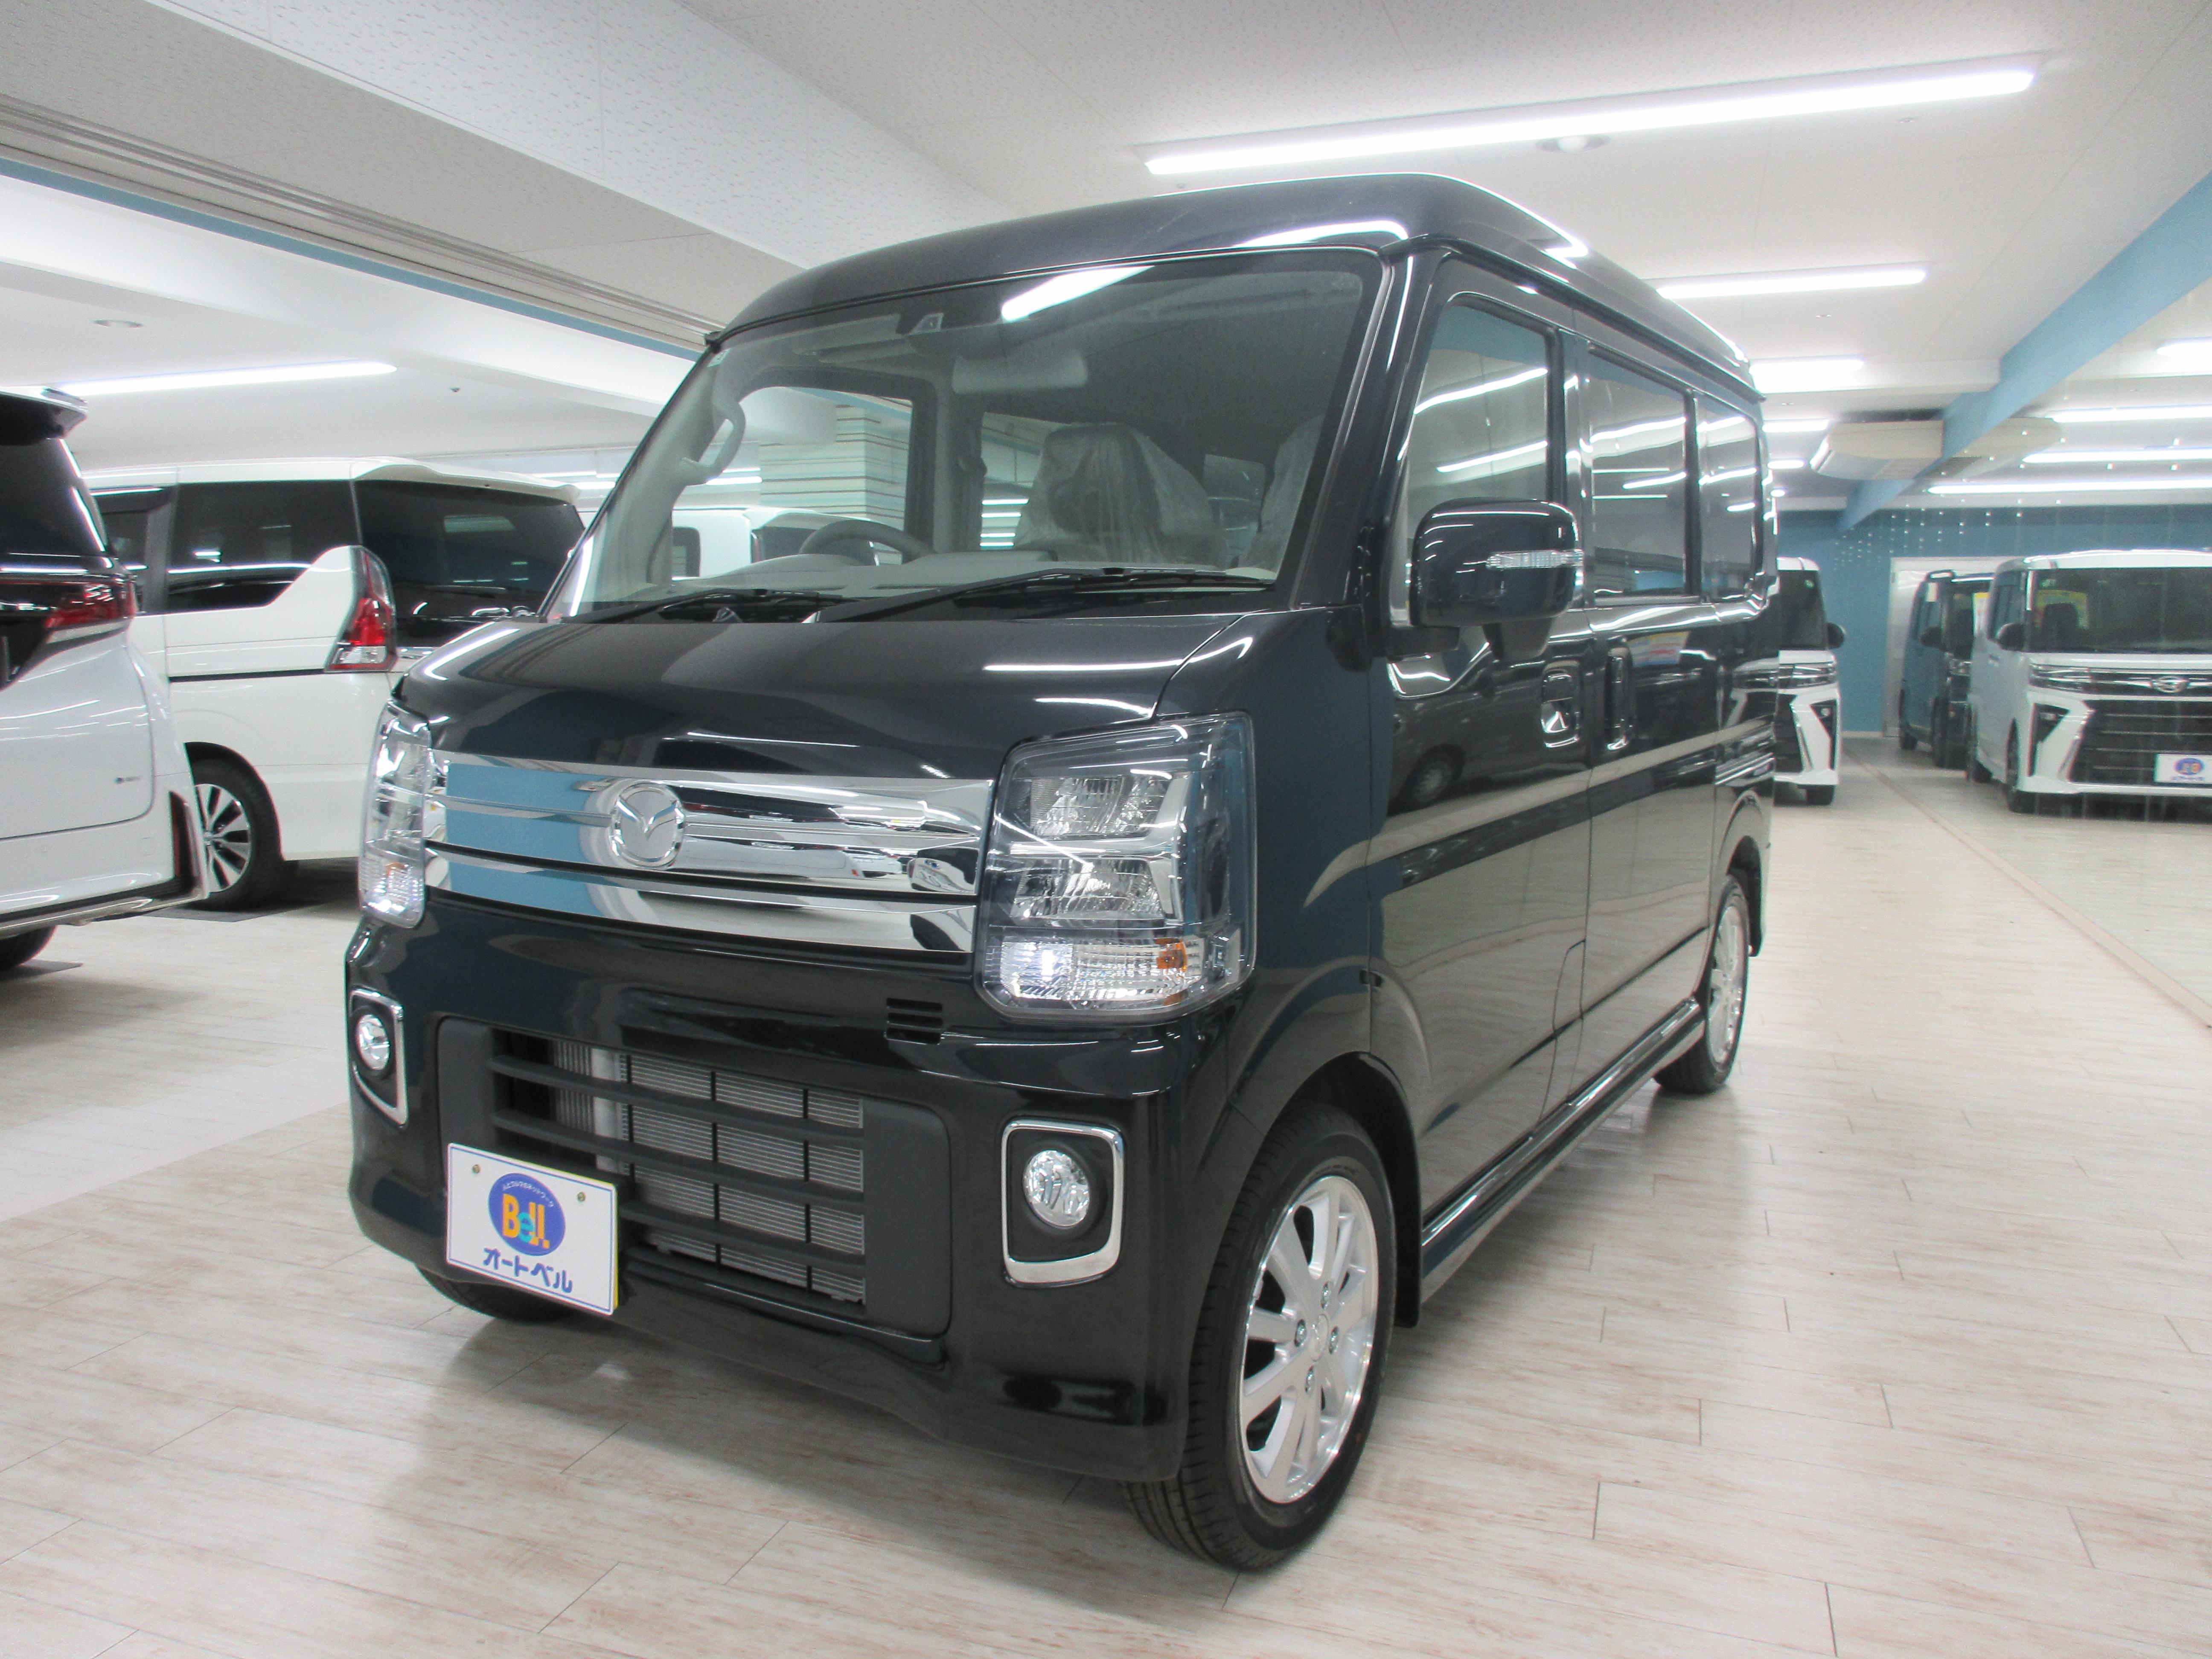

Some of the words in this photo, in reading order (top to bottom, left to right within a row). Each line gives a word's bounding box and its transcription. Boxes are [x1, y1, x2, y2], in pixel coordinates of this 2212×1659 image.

[483, 1248, 573, 1293] オートベル
